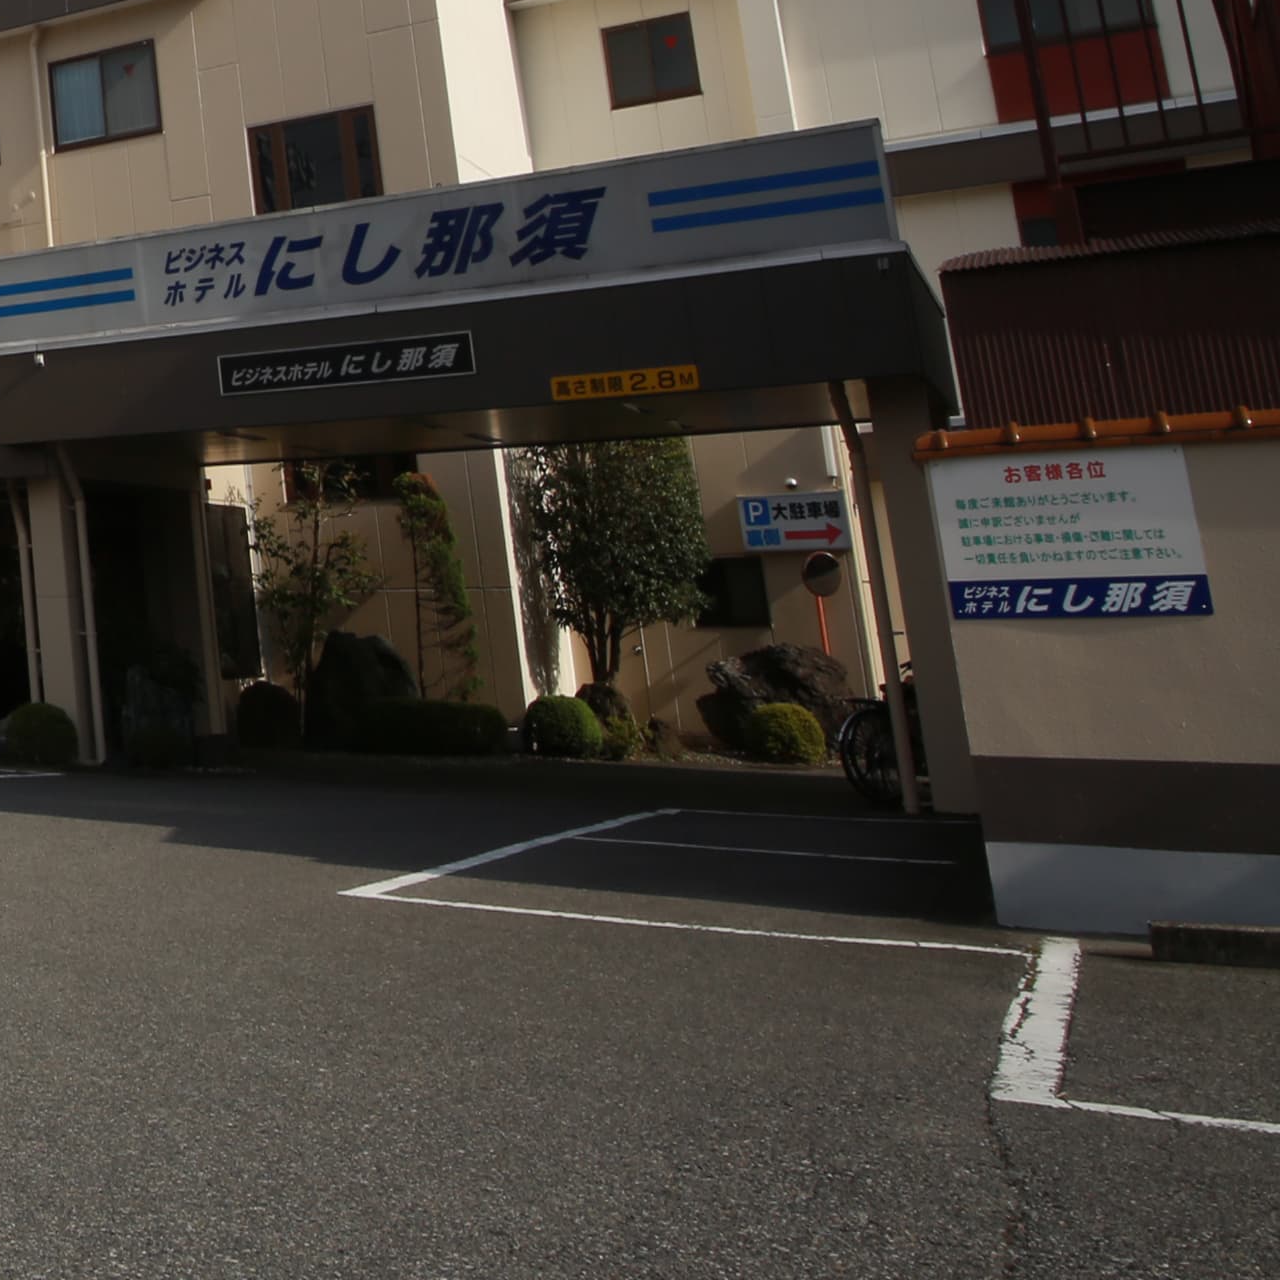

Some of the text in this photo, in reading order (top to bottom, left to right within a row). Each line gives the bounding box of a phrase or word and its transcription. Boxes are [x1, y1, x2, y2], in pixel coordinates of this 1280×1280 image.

[254, 186, 607, 297] にし那須
[164, 241, 246, 276] ビジネス
[164, 273, 246, 307] ホテル
[231, 342, 459, 388] ビジネスホテル にし那須
[555, 374, 625, 398] 高さ制限
[1002, 460, 1107, 484] お客様各位
[747, 500, 841, 523] P 大駐車場
[963, 585, 1011, 600] ビジネス
[963, 600, 1011, 614] ホテル
[1014, 580, 1197, 614] にし那須
